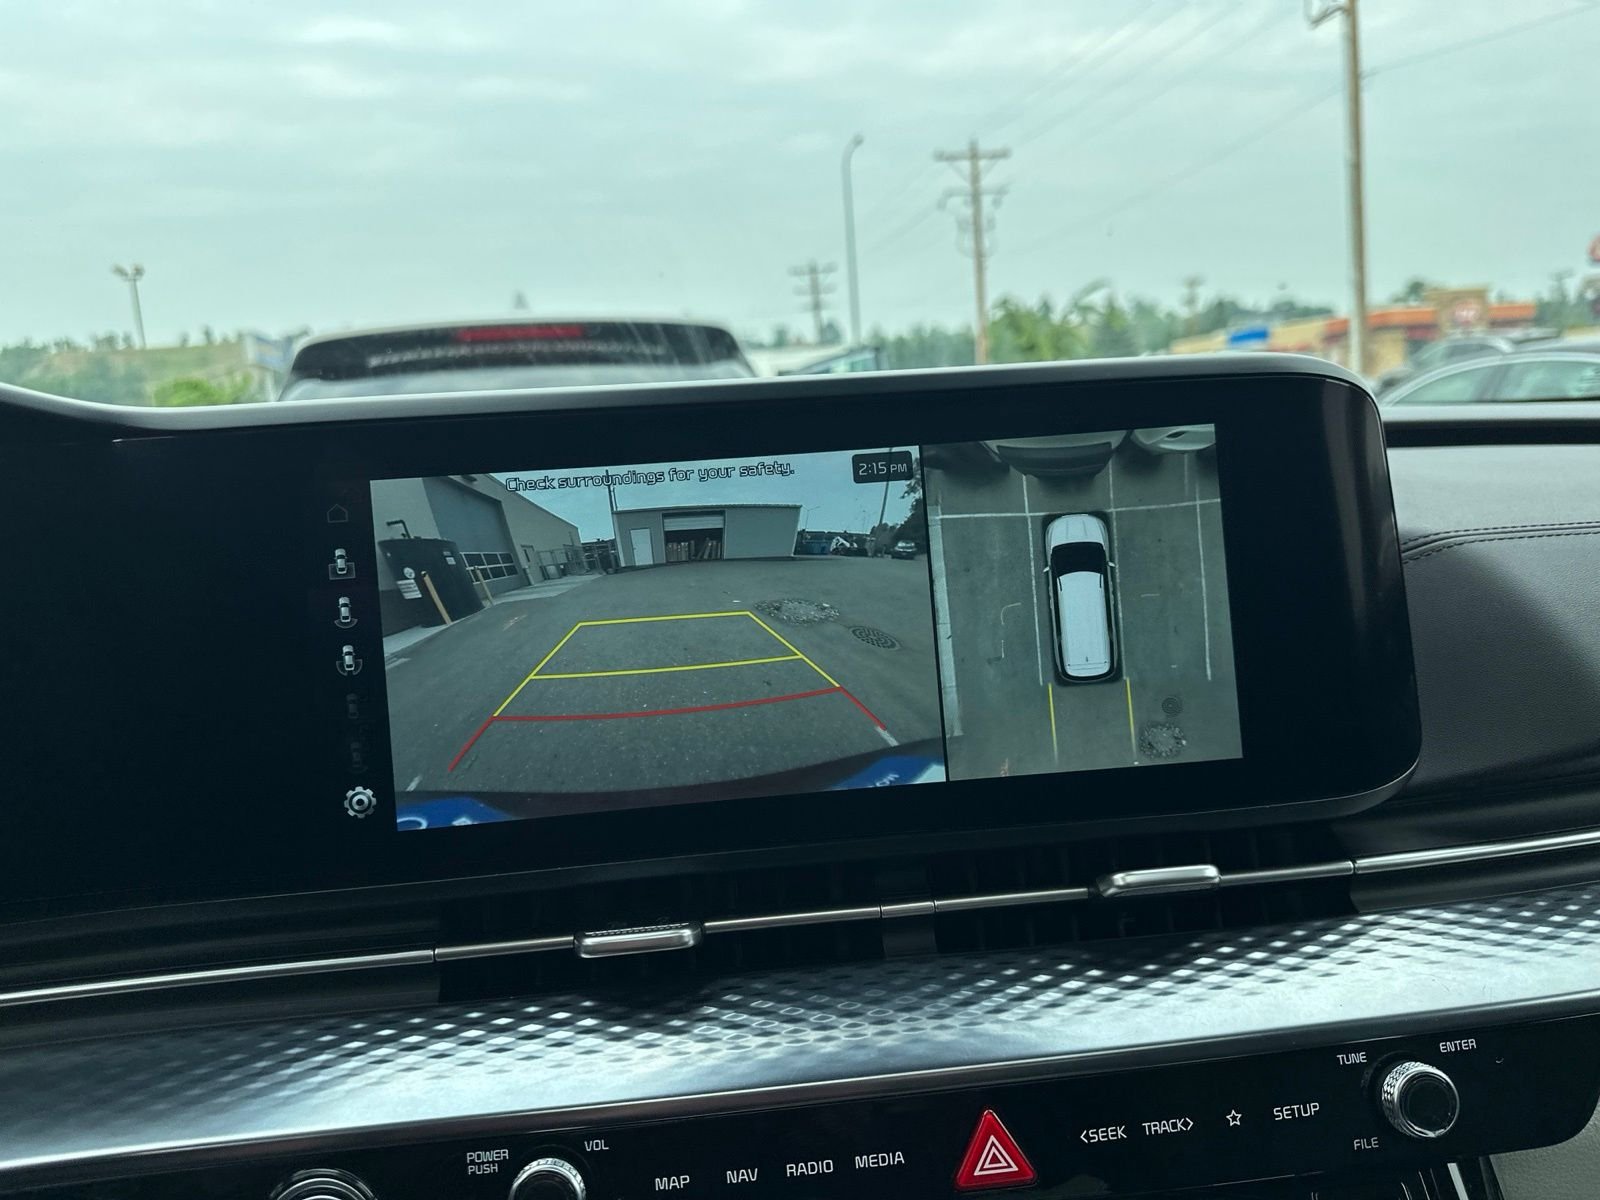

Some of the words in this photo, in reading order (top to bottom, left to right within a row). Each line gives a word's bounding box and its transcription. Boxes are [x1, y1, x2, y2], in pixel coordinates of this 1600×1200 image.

[506, 475, 556, 492] Check
[558, 471, 665, 488] surroundings
[669, 467, 694, 482] for
[698, 465, 735, 482] your
[739, 461, 795, 477] safety.
[858, 461, 887, 476] 2:15
[889, 463, 908, 474] PM
[1439, 1038, 1477, 1054] ENTER
[1337, 1052, 1367, 1066] TUNE
[1273, 1102, 1320, 1120] SETUP
[584, 1139, 609, 1152] VOL
[1353, 1136, 1379, 1151] FILE
[466, 1149, 509, 1163] POWER
[855, 1151, 905, 1169] MEDIA
[467, 1163, 498, 1175] PUSH
[726, 1168, 758, 1184] NAV
[786, 1159, 834, 1177] RADIO
[655, 1175, 690, 1191] MAP
